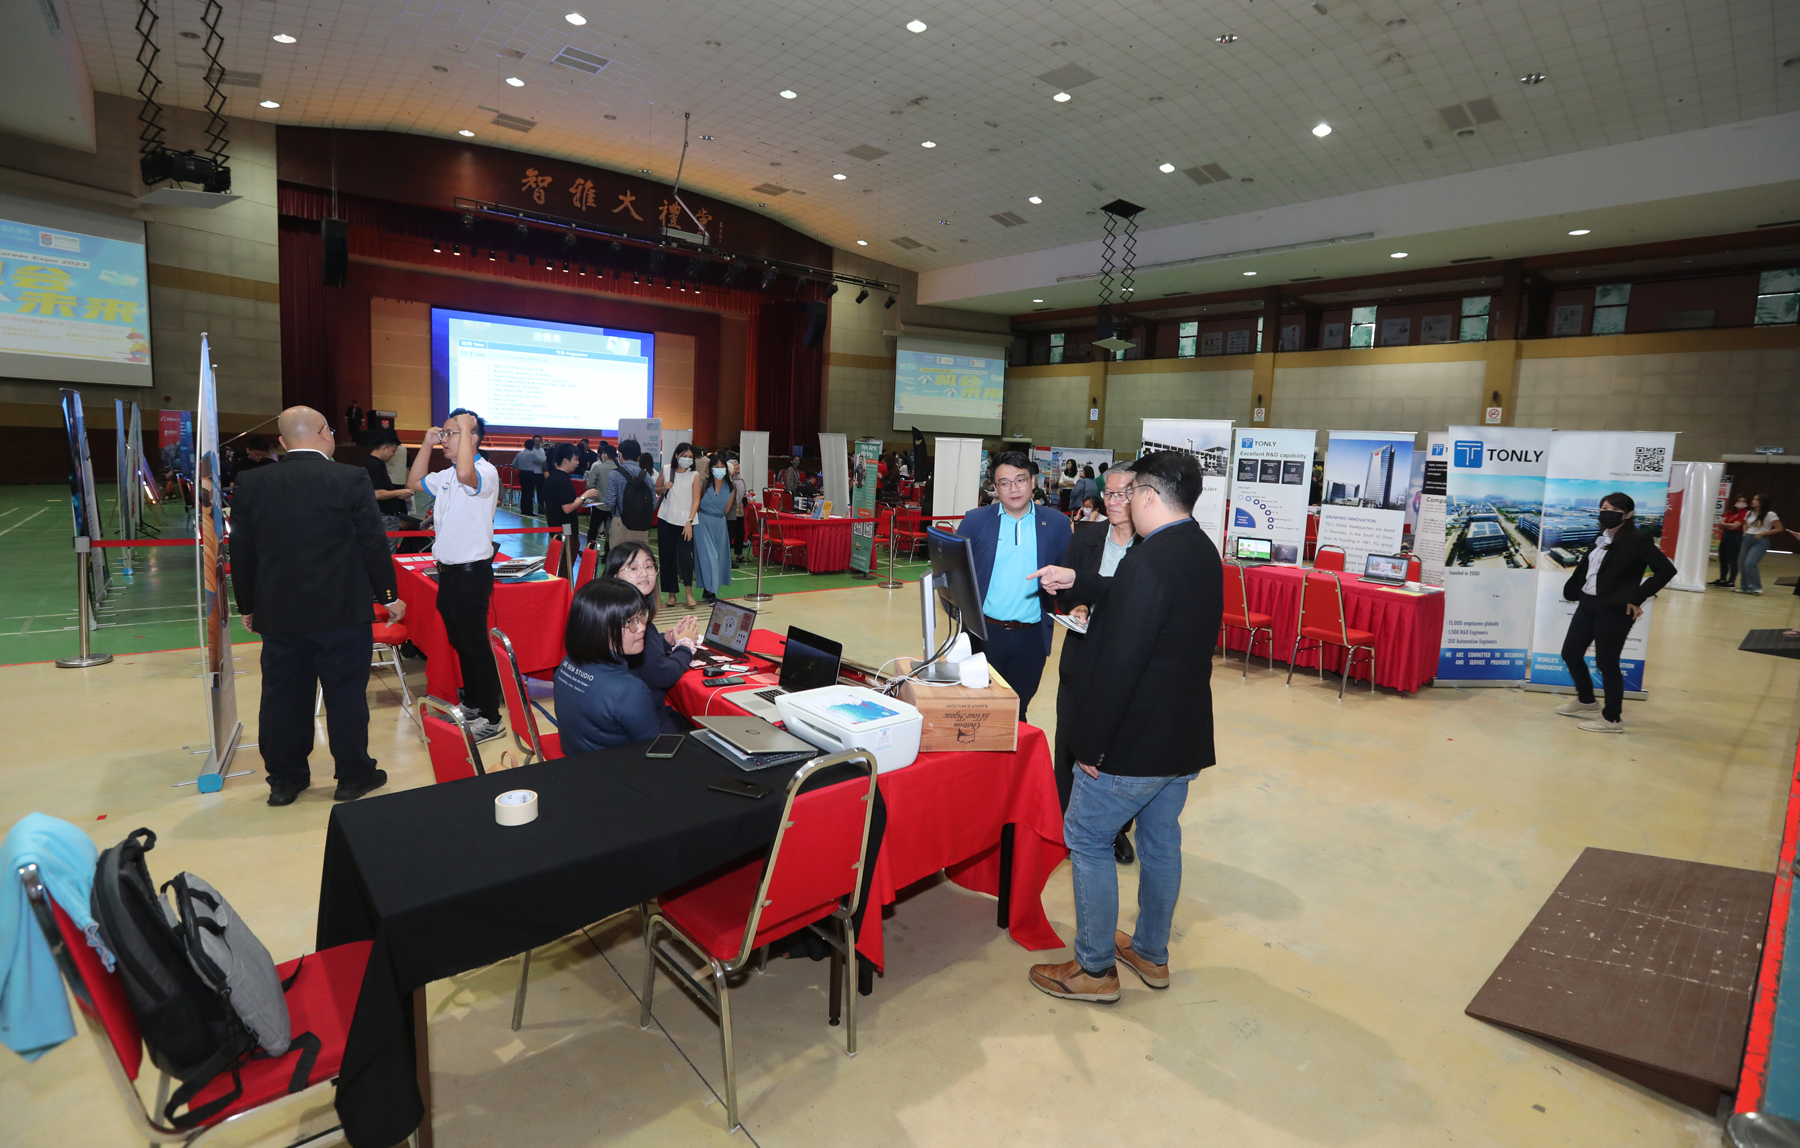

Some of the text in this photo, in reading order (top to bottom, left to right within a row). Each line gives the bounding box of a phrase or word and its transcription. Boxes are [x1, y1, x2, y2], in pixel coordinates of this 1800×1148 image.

[0, 251, 88, 267] areer Expo 2023
[1279, 452, 1307, 460] capability
[1486, 448, 1544, 463] TONLY
[1536, 656, 1559, 664] WORLD'S
[575, 668, 594, 681] STUDIO
[943, 711, 967, 722] Figeac
